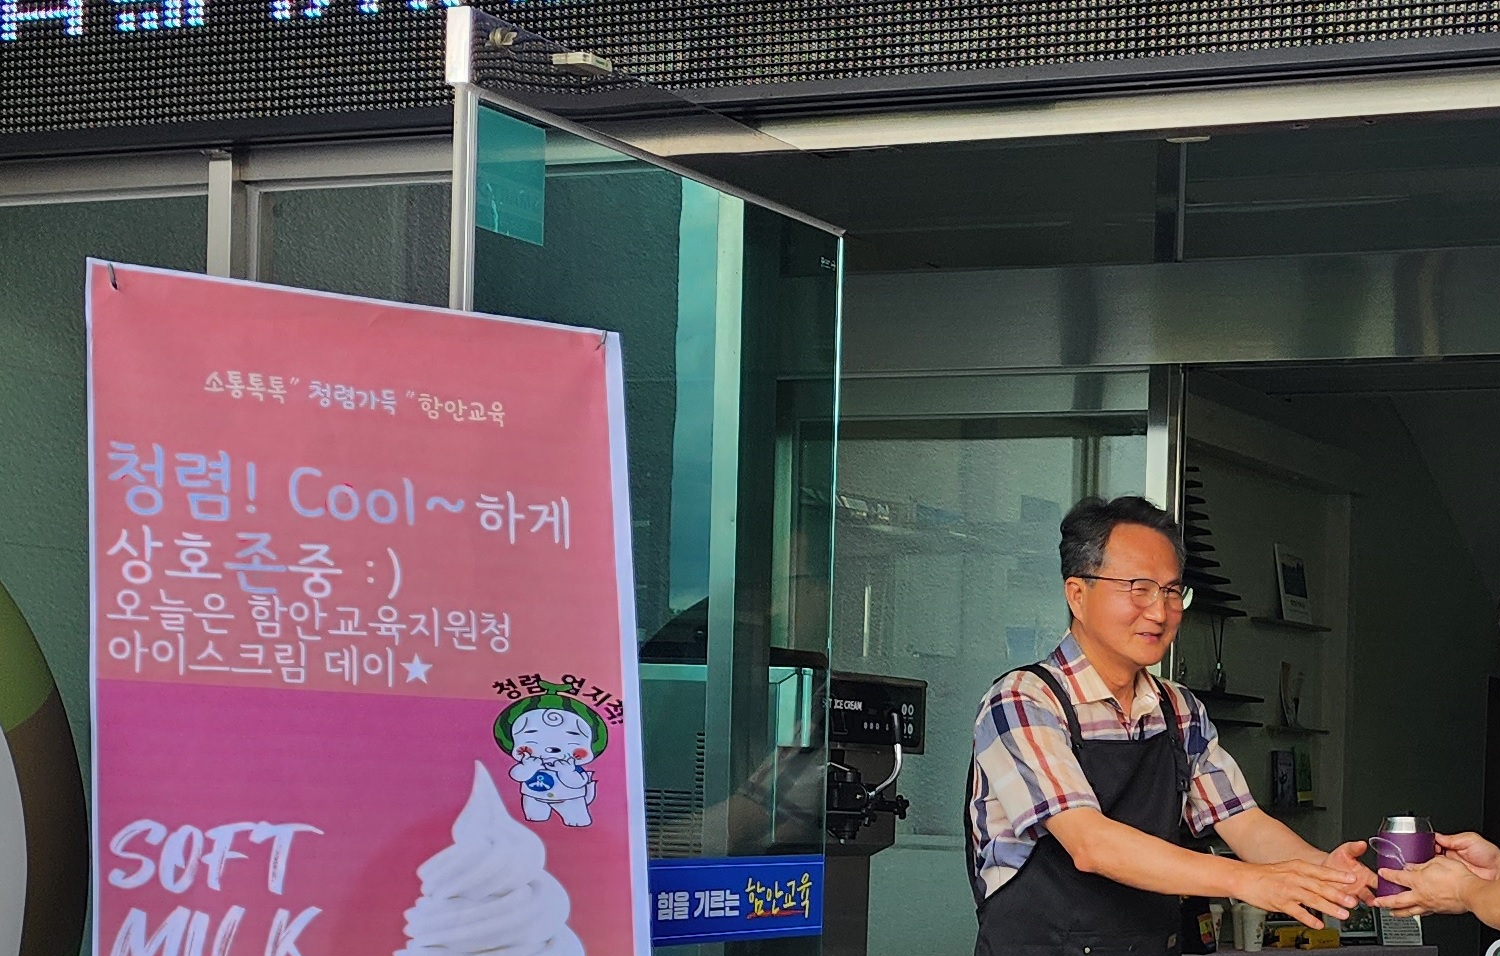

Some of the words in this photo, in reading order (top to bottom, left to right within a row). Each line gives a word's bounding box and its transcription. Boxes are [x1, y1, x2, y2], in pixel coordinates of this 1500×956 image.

[308, 381, 397, 415] 청렴가득
[107, 441, 258, 522] 청렴!
[106, 525, 343, 599] 상호존중
[106, 588, 235, 635] 오늘은
[248, 594, 511, 653] 함안교육지원청
[108, 630, 306, 684] 아이스크림
[492, 673, 546, 700] 청렴
[108, 819, 324, 895] SOFT
[657, 892, 690, 920] 힘을
[694, 890, 740, 918] 기르는
[745, 872, 812, 919] 함안교육
